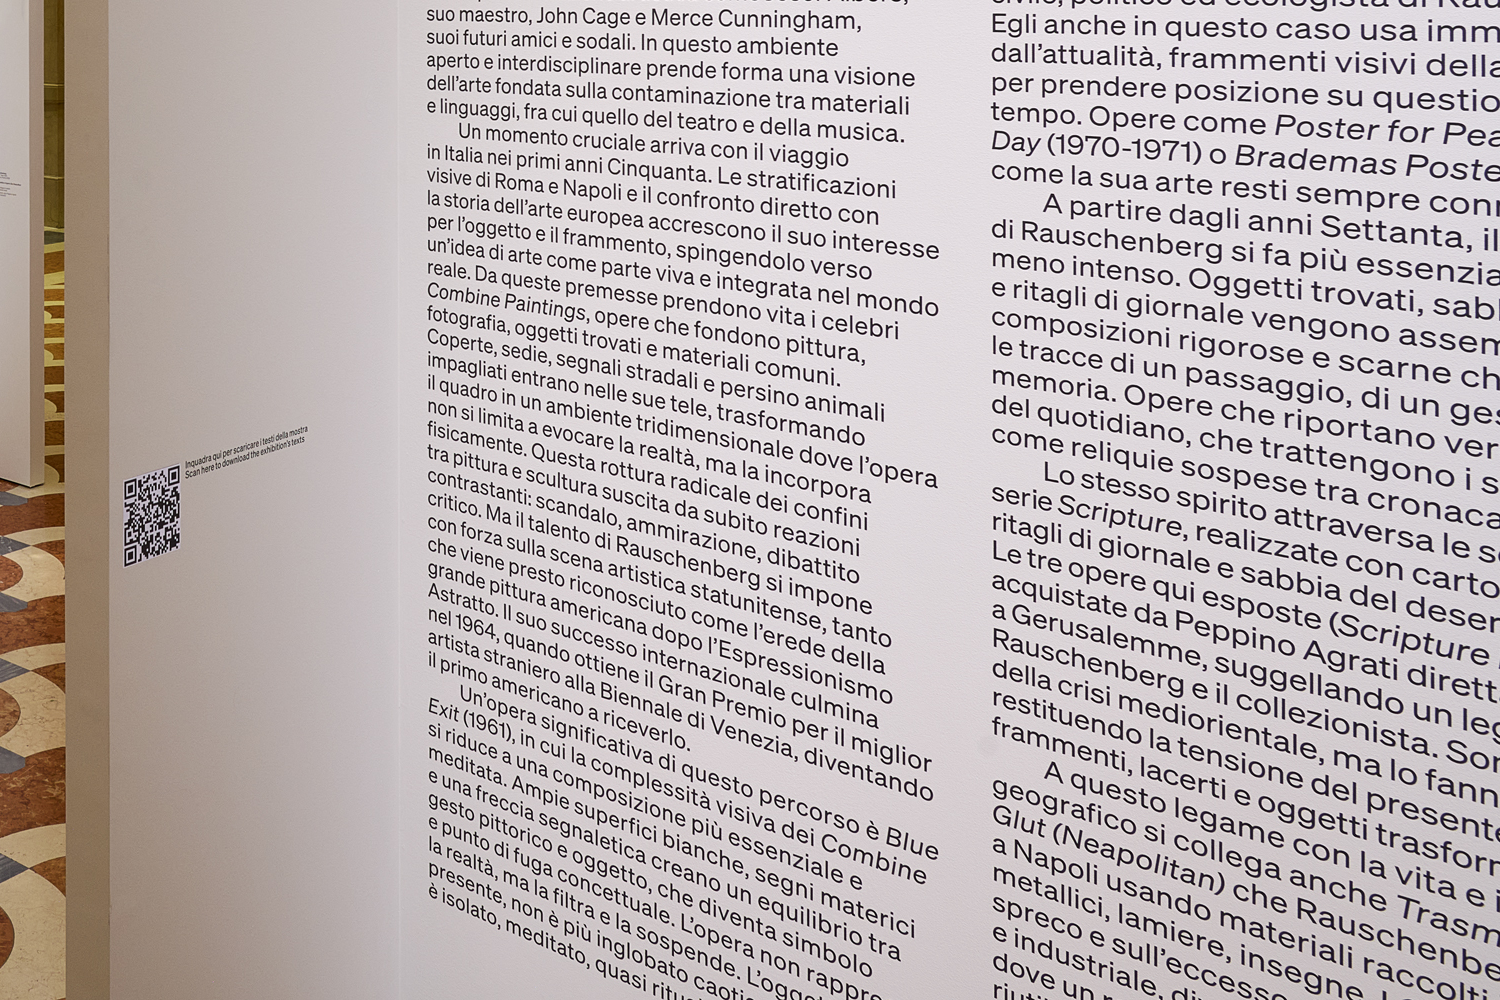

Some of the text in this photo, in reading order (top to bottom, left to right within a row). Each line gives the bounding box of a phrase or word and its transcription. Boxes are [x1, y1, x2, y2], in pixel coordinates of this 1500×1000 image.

[426, 6, 862, 34] suo maestro, John Cage e Merce Cunningham,
[427, 144, 896, 199] in Italia nei primi anni Cinquanta. Le stratificazioni
[991, 129, 1042, 157] Day
[1047, 132, 1202, 166] (1970-1971)
[1209, 147, 1227, 165] o
[1234, 143, 1398, 176] Brademas
[427, 281, 866, 367] Combine Paintings, opere che fondono pittura,
[185, 455, 211, 468] Inquadra
[213, 451, 221, 462] qui
[223, 449, 232, 460] per
[233, 441, 259, 454] scaricare
[263, 434, 275, 445] testi
[276, 431, 288, 441] della
[289, 425, 308, 437] mostra
[185, 468, 200, 479] Scan
[201, 463, 214, 474] here
[215, 461, 221, 470] to
[222, 452, 249, 468] download
[250, 449, 259, 459] the
[292, 435, 305, 446] texts
[991, 428, 1065, 454] come
[1071, 440, 1174, 473] reliquie
[1180, 459, 1308, 497] sospese
[1314, 477, 1360, 506] tra
[991, 574, 1128, 619] acquistate
[1133, 602, 1169, 629] da
[1175, 609, 1296, 657] Peppino
[1302, 639, 1398, 681] Agrati
[428, 697, 927, 885] Exit (1961), in cui la complessità visiva dei Combine
[992, 837, 1008, 856] a
[1014, 838, 1098, 886] Napoli
[1106, 873, 1212, 921] usando
[1219, 910, 1353, 969] materiali
